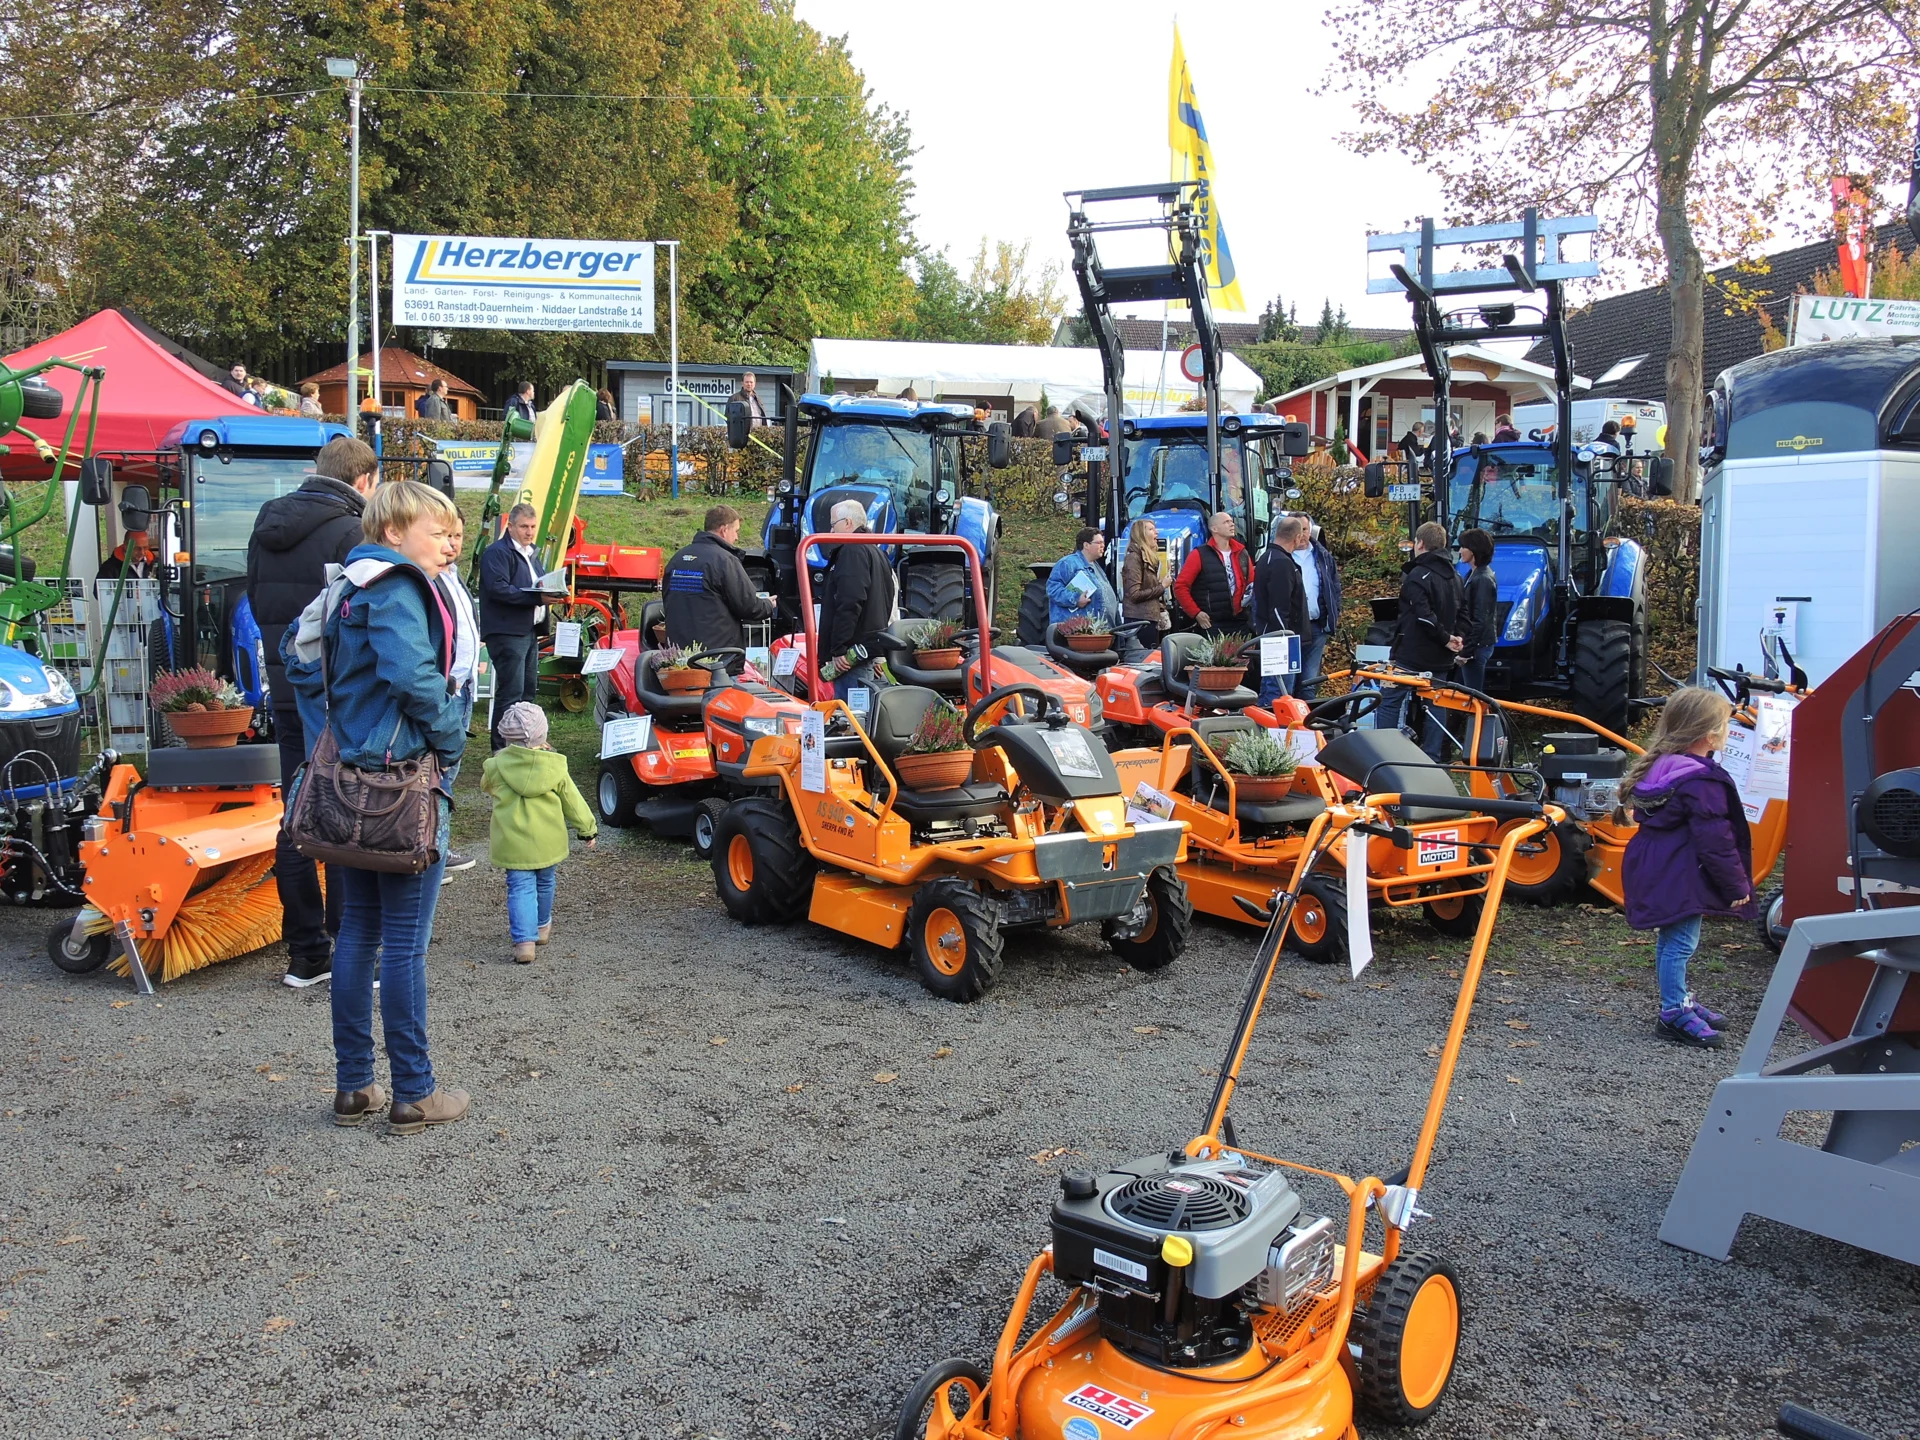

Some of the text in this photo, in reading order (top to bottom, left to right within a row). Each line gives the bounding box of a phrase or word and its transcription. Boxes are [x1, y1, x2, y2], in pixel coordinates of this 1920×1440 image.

[437, 241, 642, 279] Herzberger
[404, 287, 429, 295] Land-
[434, 288, 467, 296] Garten-
[473, 289, 498, 297] Forst-
[503, 290, 554, 300] Reinigungs-
[568, 292, 643, 302] Kommunaltechnik
[404, 300, 643, 316] 63691 Ranstadt-Dauernheim Niddaer Landstraße 14
[1809, 300, 1885, 322] LUTZ
[404, 312, 419, 321] Tel.
[429, 313, 441, 322] 60
[472, 314, 484, 324] 99
[487, 315, 498, 324] 90
[504, 316, 643, 329] www.herzberger-gartentechnik.de
[665, 377, 735, 395] Grtenmöbel
[1778, 438, 1821, 447] HUMBAUR
[445, 449, 513, 459] VOLL AUF SPR
[1114, 758, 1160, 769] FREERIDER
[816, 800, 828, 817] AS
[821, 820, 837, 833] SHERPA
[1421, 831, 1456, 852] AS
[1422, 851, 1454, 863] MOTOR
[1071, 1397, 1130, 1425] MOTOR
[1078, 1386, 1149, 1419] AS
